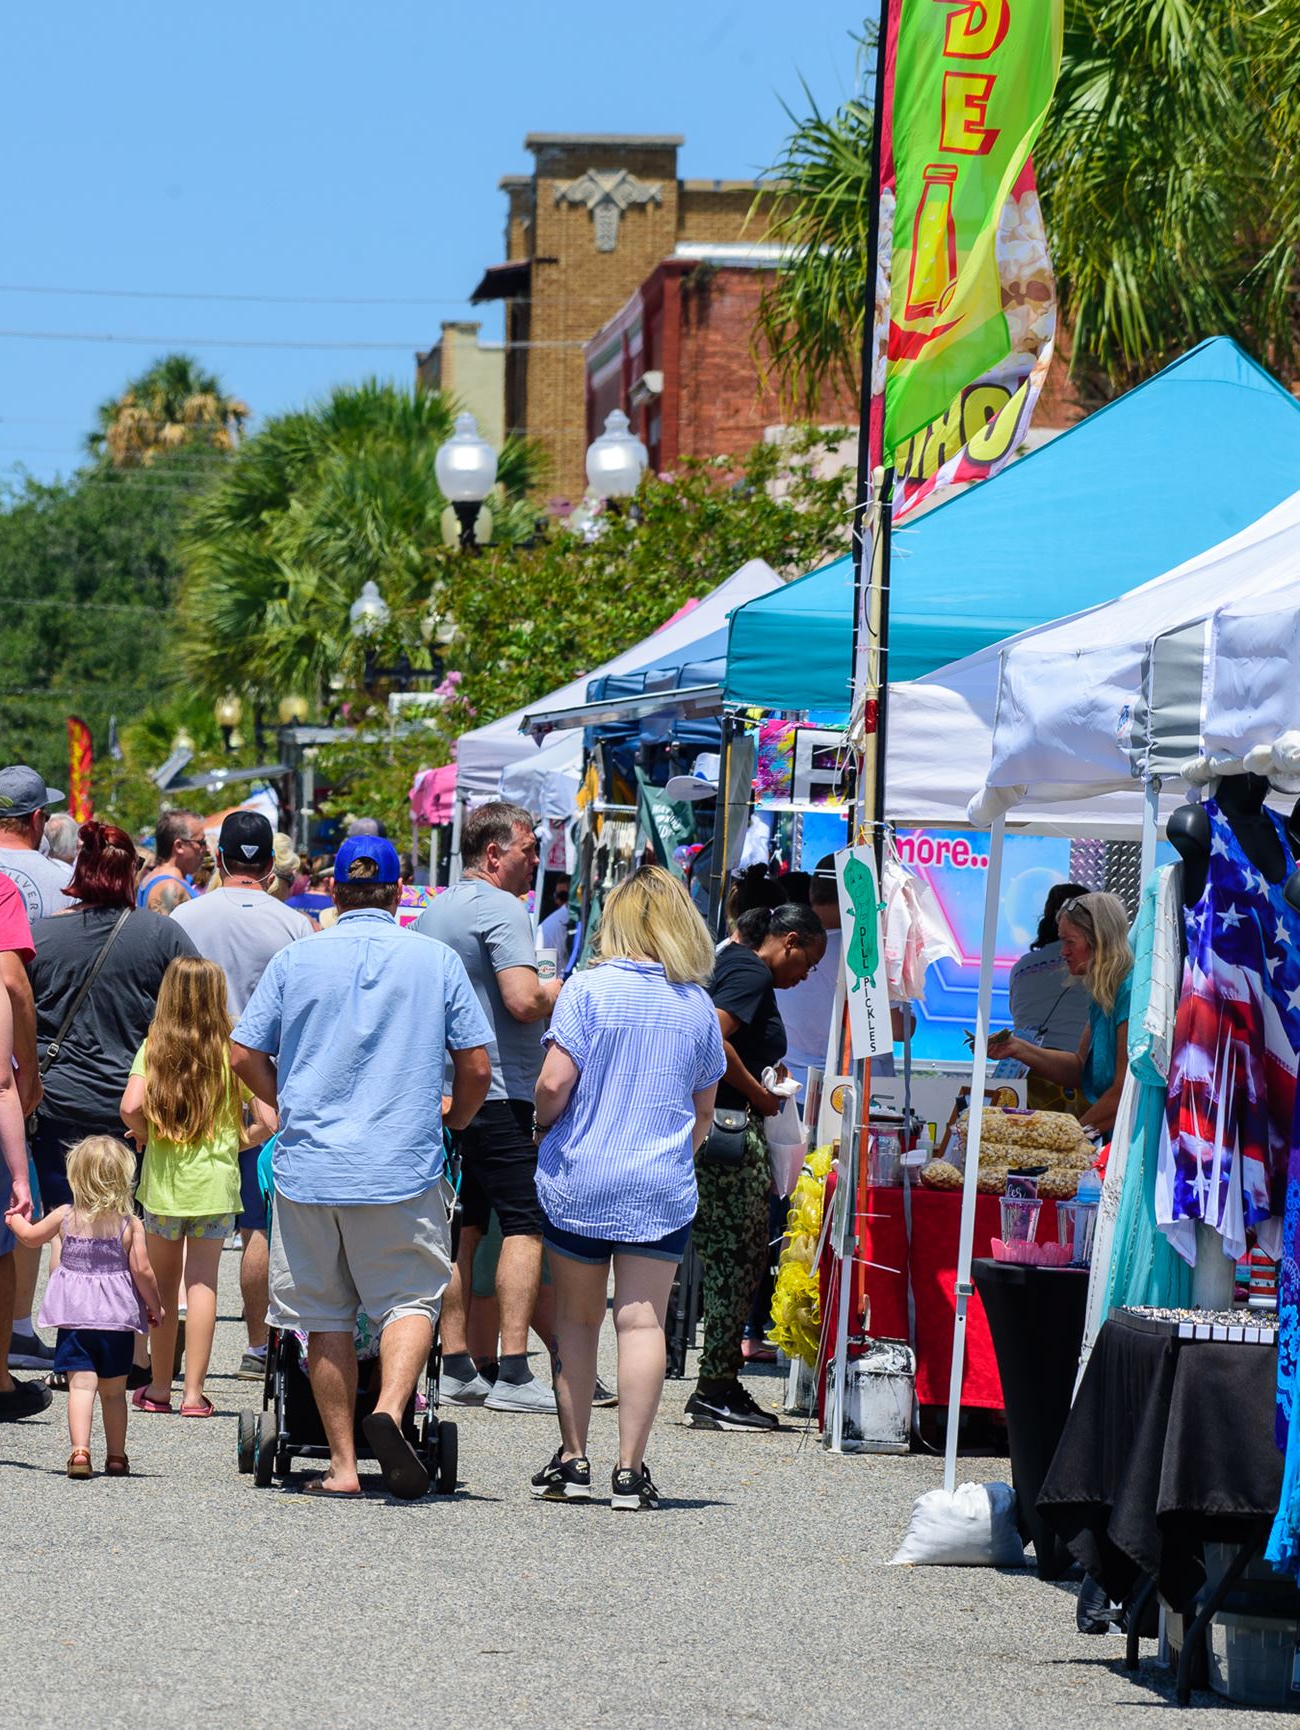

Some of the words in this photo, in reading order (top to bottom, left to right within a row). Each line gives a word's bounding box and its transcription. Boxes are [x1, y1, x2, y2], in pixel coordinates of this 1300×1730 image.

[4, 869, 39, 911] ILVER
[859, 926, 870, 970] DILL
[863, 977, 877, 1053] PICKLES
